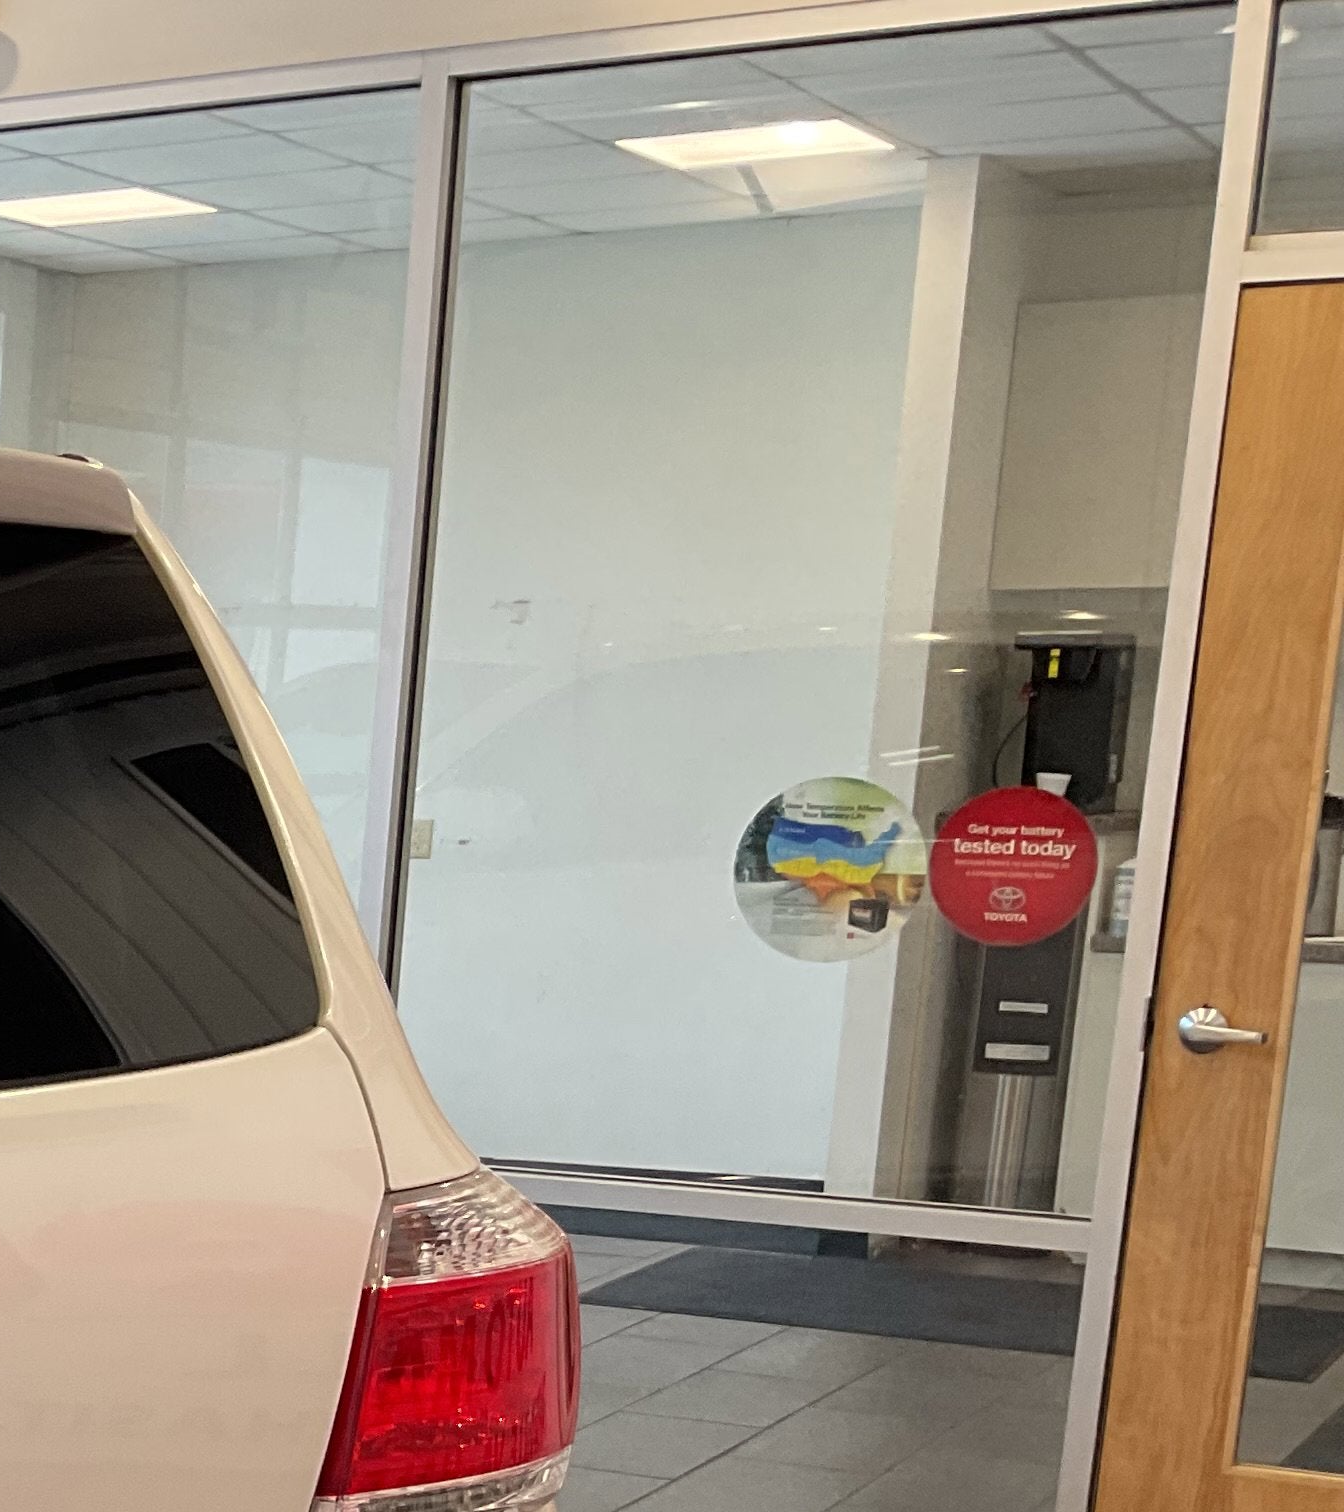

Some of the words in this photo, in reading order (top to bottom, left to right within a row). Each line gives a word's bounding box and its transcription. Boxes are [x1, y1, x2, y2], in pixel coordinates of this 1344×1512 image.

[967, 823, 990, 834] Get
[991, 826, 1019, 837] your
[1020, 825, 1065, 839] battery
[953, 837, 1016, 856] tested
[1020, 840, 1077, 861] today
[983, 912, 1028, 923] TOYOTA
